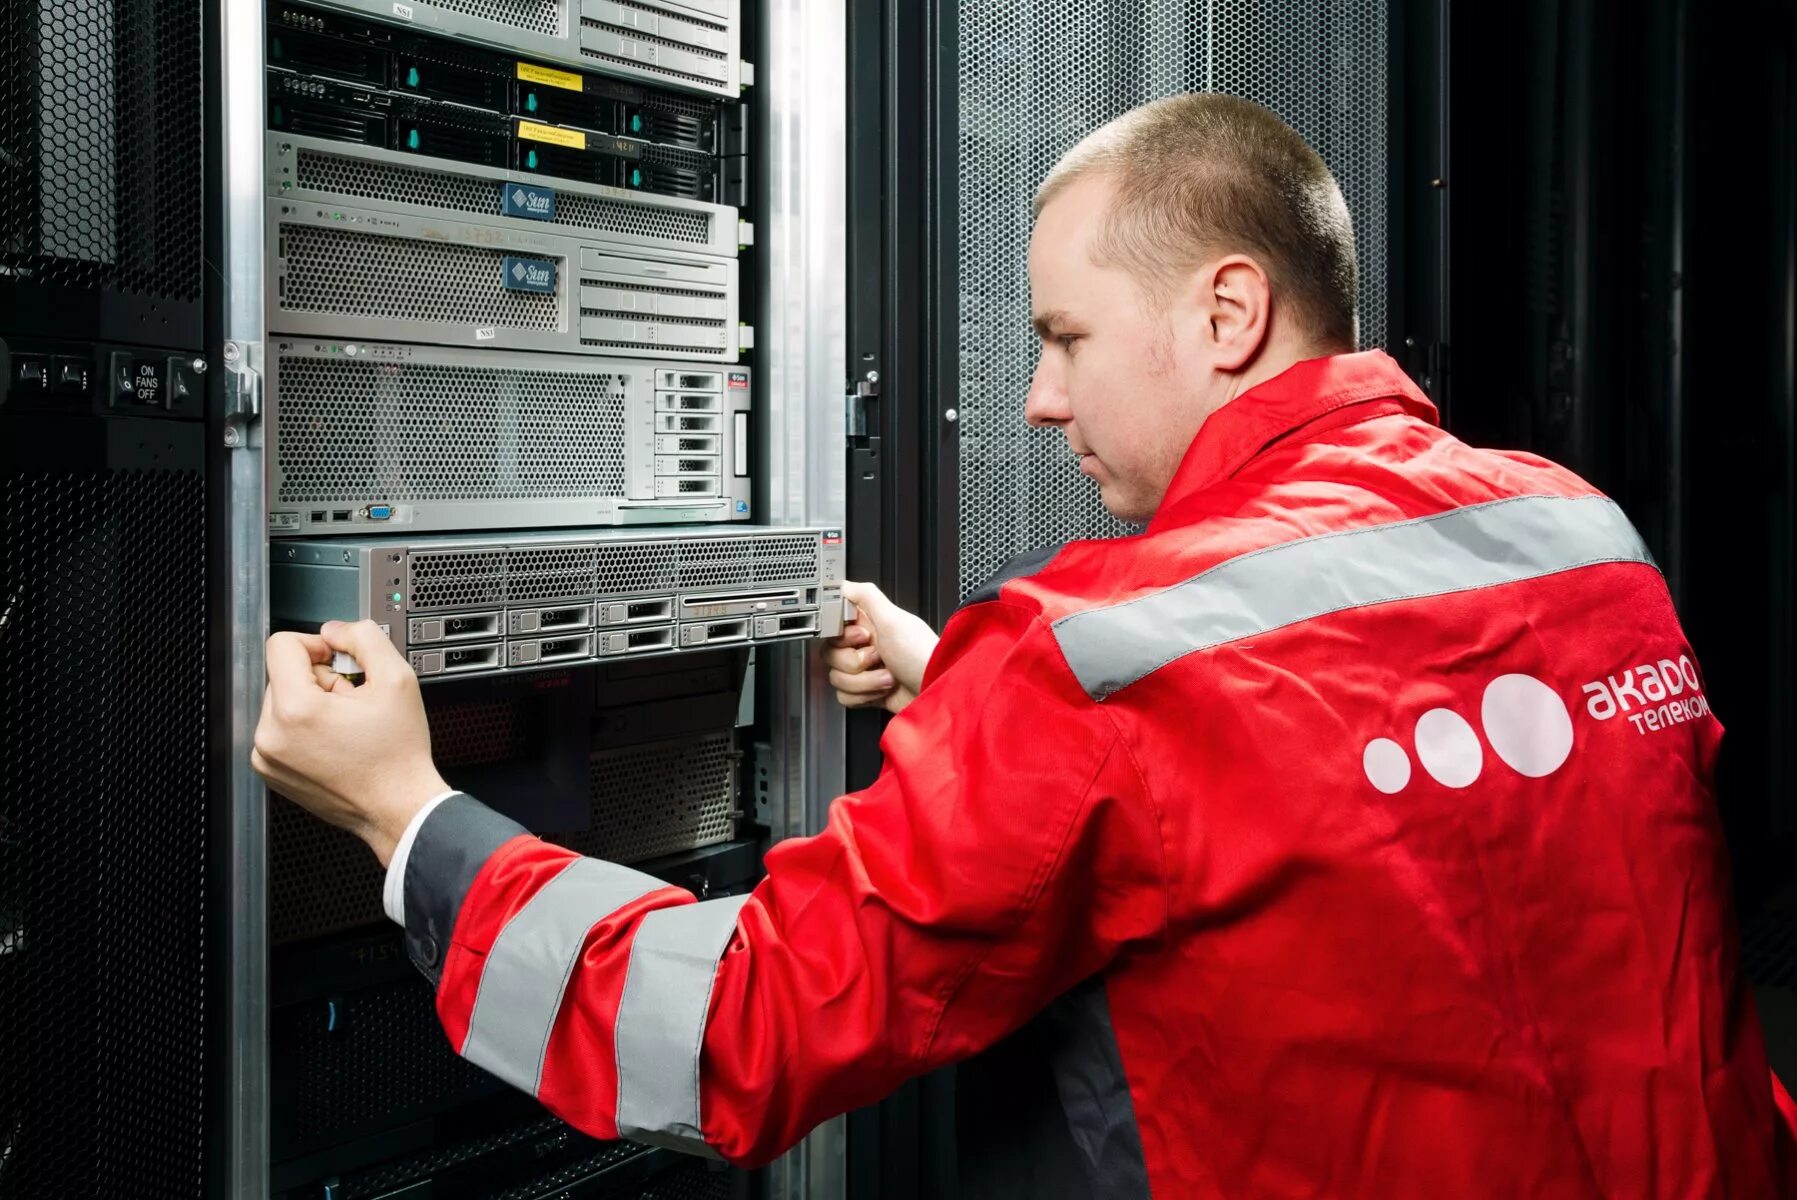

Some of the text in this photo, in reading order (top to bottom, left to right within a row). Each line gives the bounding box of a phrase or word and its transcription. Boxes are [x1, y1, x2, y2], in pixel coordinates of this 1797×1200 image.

[526, 192, 550, 209] Sun
[526, 265, 550, 282] Sun
[140, 365, 154, 376] ON
[135, 377, 158, 388] FANS
[137, 388, 156, 399] OFF
